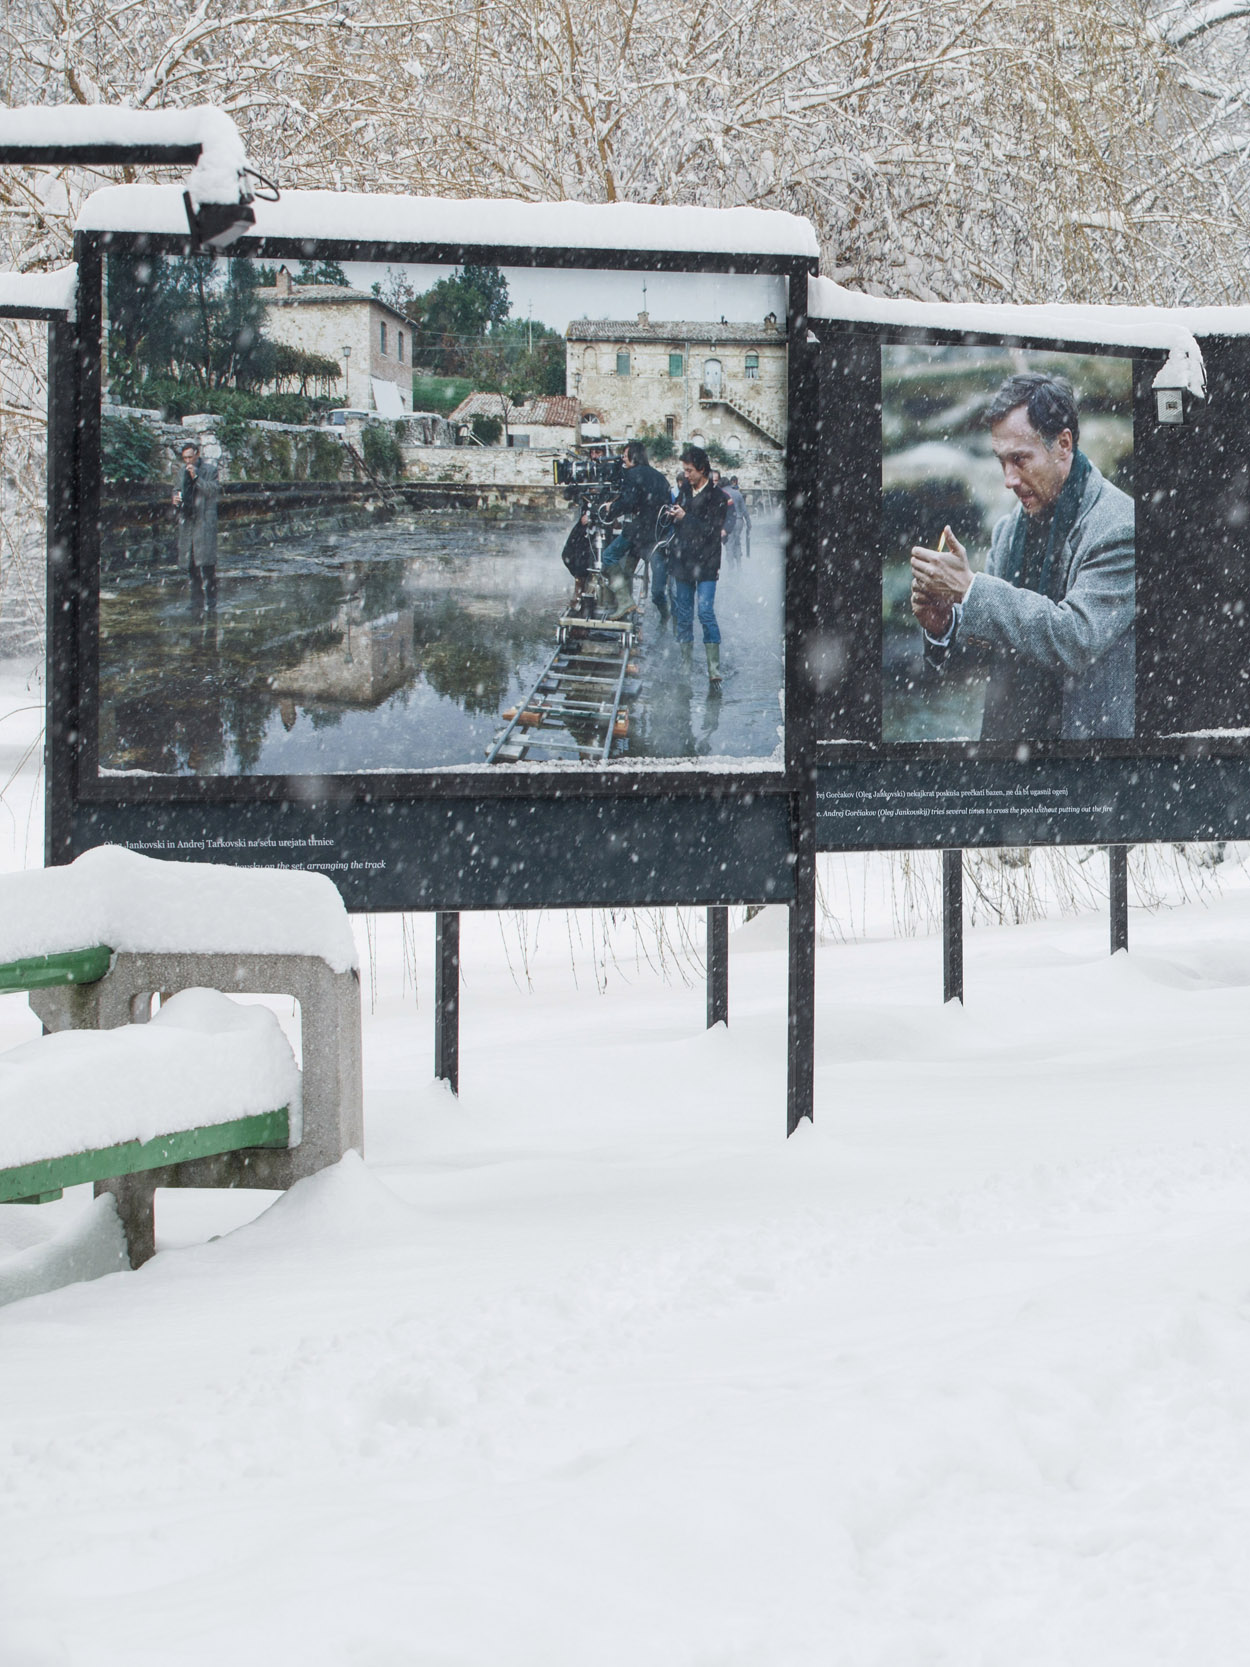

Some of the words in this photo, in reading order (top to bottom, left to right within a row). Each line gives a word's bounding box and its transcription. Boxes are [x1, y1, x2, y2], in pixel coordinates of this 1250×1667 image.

[855, 790, 873, 800] (Oleg
[823, 809, 845, 818] Andrej
[877, 808, 894, 818] (Oleg
[1010, 806, 1020, 814] the
[1020, 806, 1034, 815] pool
[1034, 805, 1058, 814] without
[1058, 805, 1080, 815] putting
[1092, 805, 1101, 813] the
[1101, 805, 1113, 814] fire
[125, 840, 165, 849] Jankovski
[167, 840, 176, 849] in
[177, 839, 205, 850] Andrej
[206, 838, 247, 848] Tarkovski
[260, 839, 277, 847] setu
[278, 838, 307, 849] urejata
[277, 861, 290, 870] the
[291, 862, 306, 871] set,
[307, 860, 349, 872] arranging
[350, 860, 363, 869] the
[364, 859, 387, 869] track
